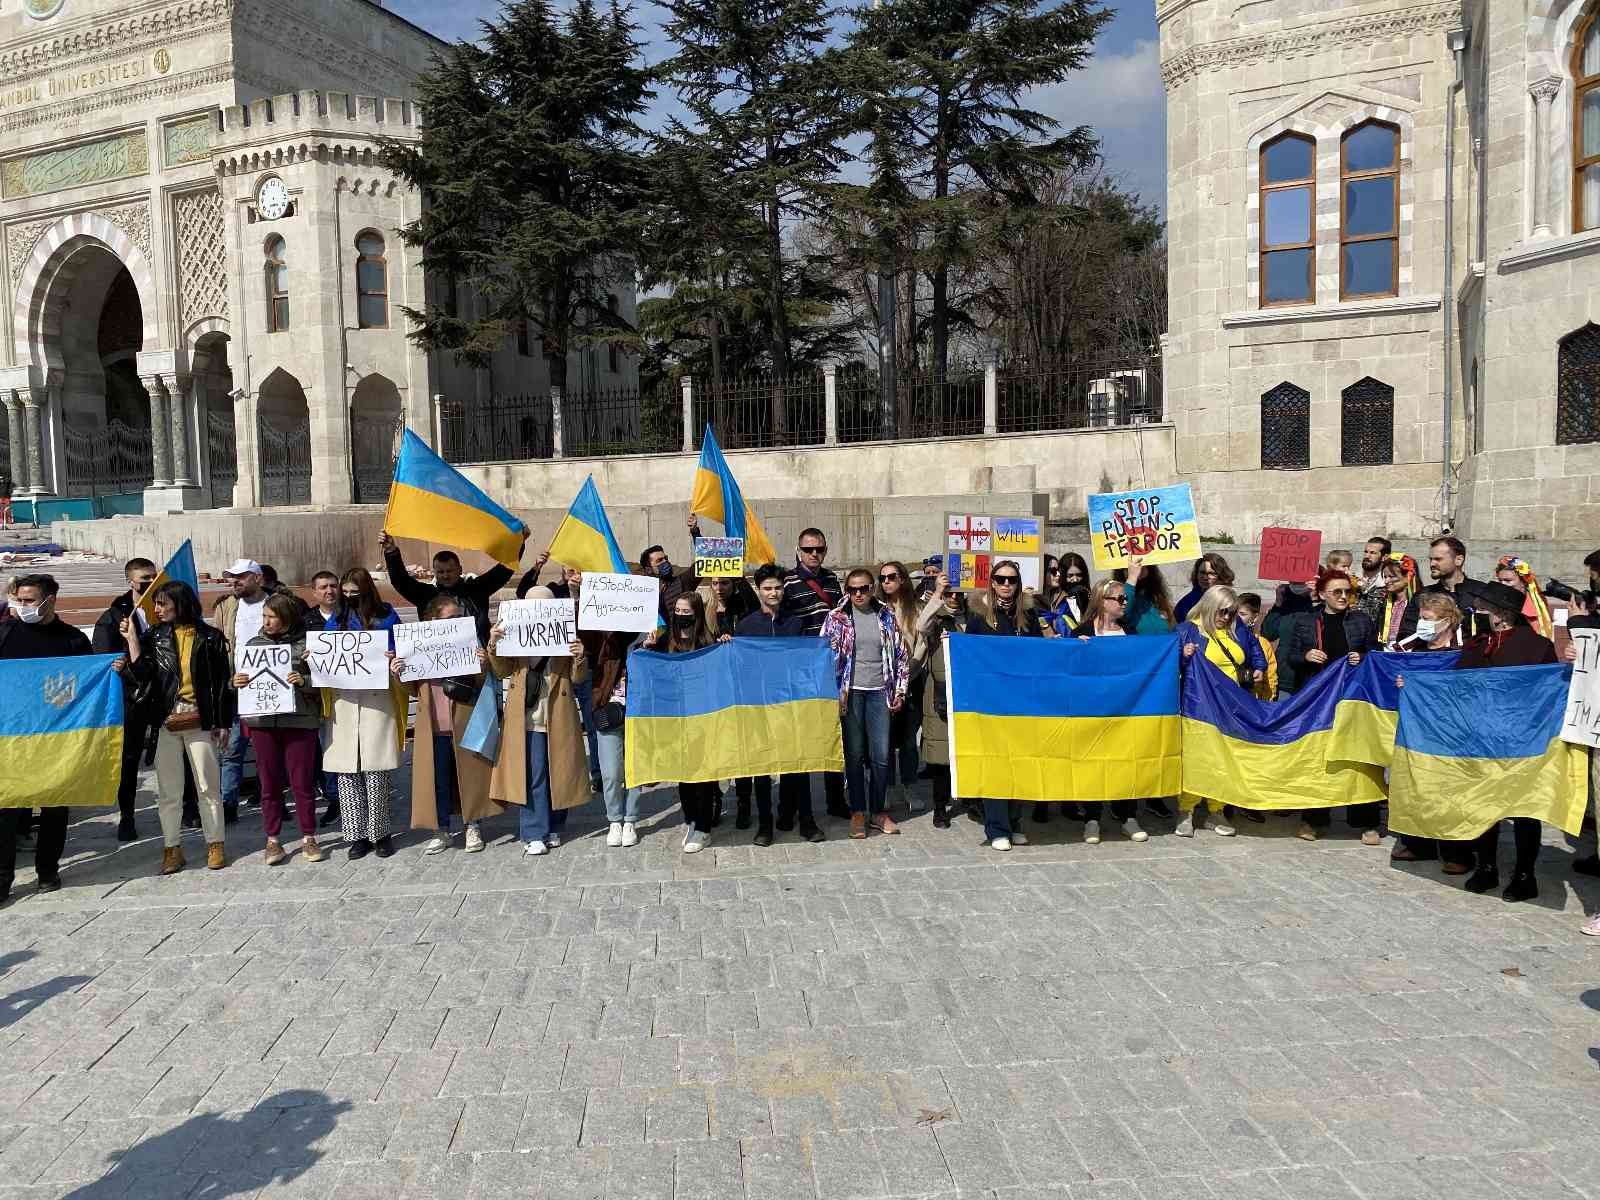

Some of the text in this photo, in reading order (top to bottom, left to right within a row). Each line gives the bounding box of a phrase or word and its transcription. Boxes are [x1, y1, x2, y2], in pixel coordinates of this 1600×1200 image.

[1115, 495, 1160, 518] STOP
[960, 527, 1028, 544] WHO WILL
[1103, 532, 1181, 558] TERROR
[1263, 530, 1311, 549] STOP
[695, 559, 741, 577] PEACE
[313, 631, 372, 655] STOP
[518, 618, 575, 648] UKRAINE
[240, 647, 290, 669] NATO
[311, 652, 372, 676] WAR
[248, 680, 279, 692] close
[255, 691, 280, 703] the
[255, 701, 281, 712] sky
